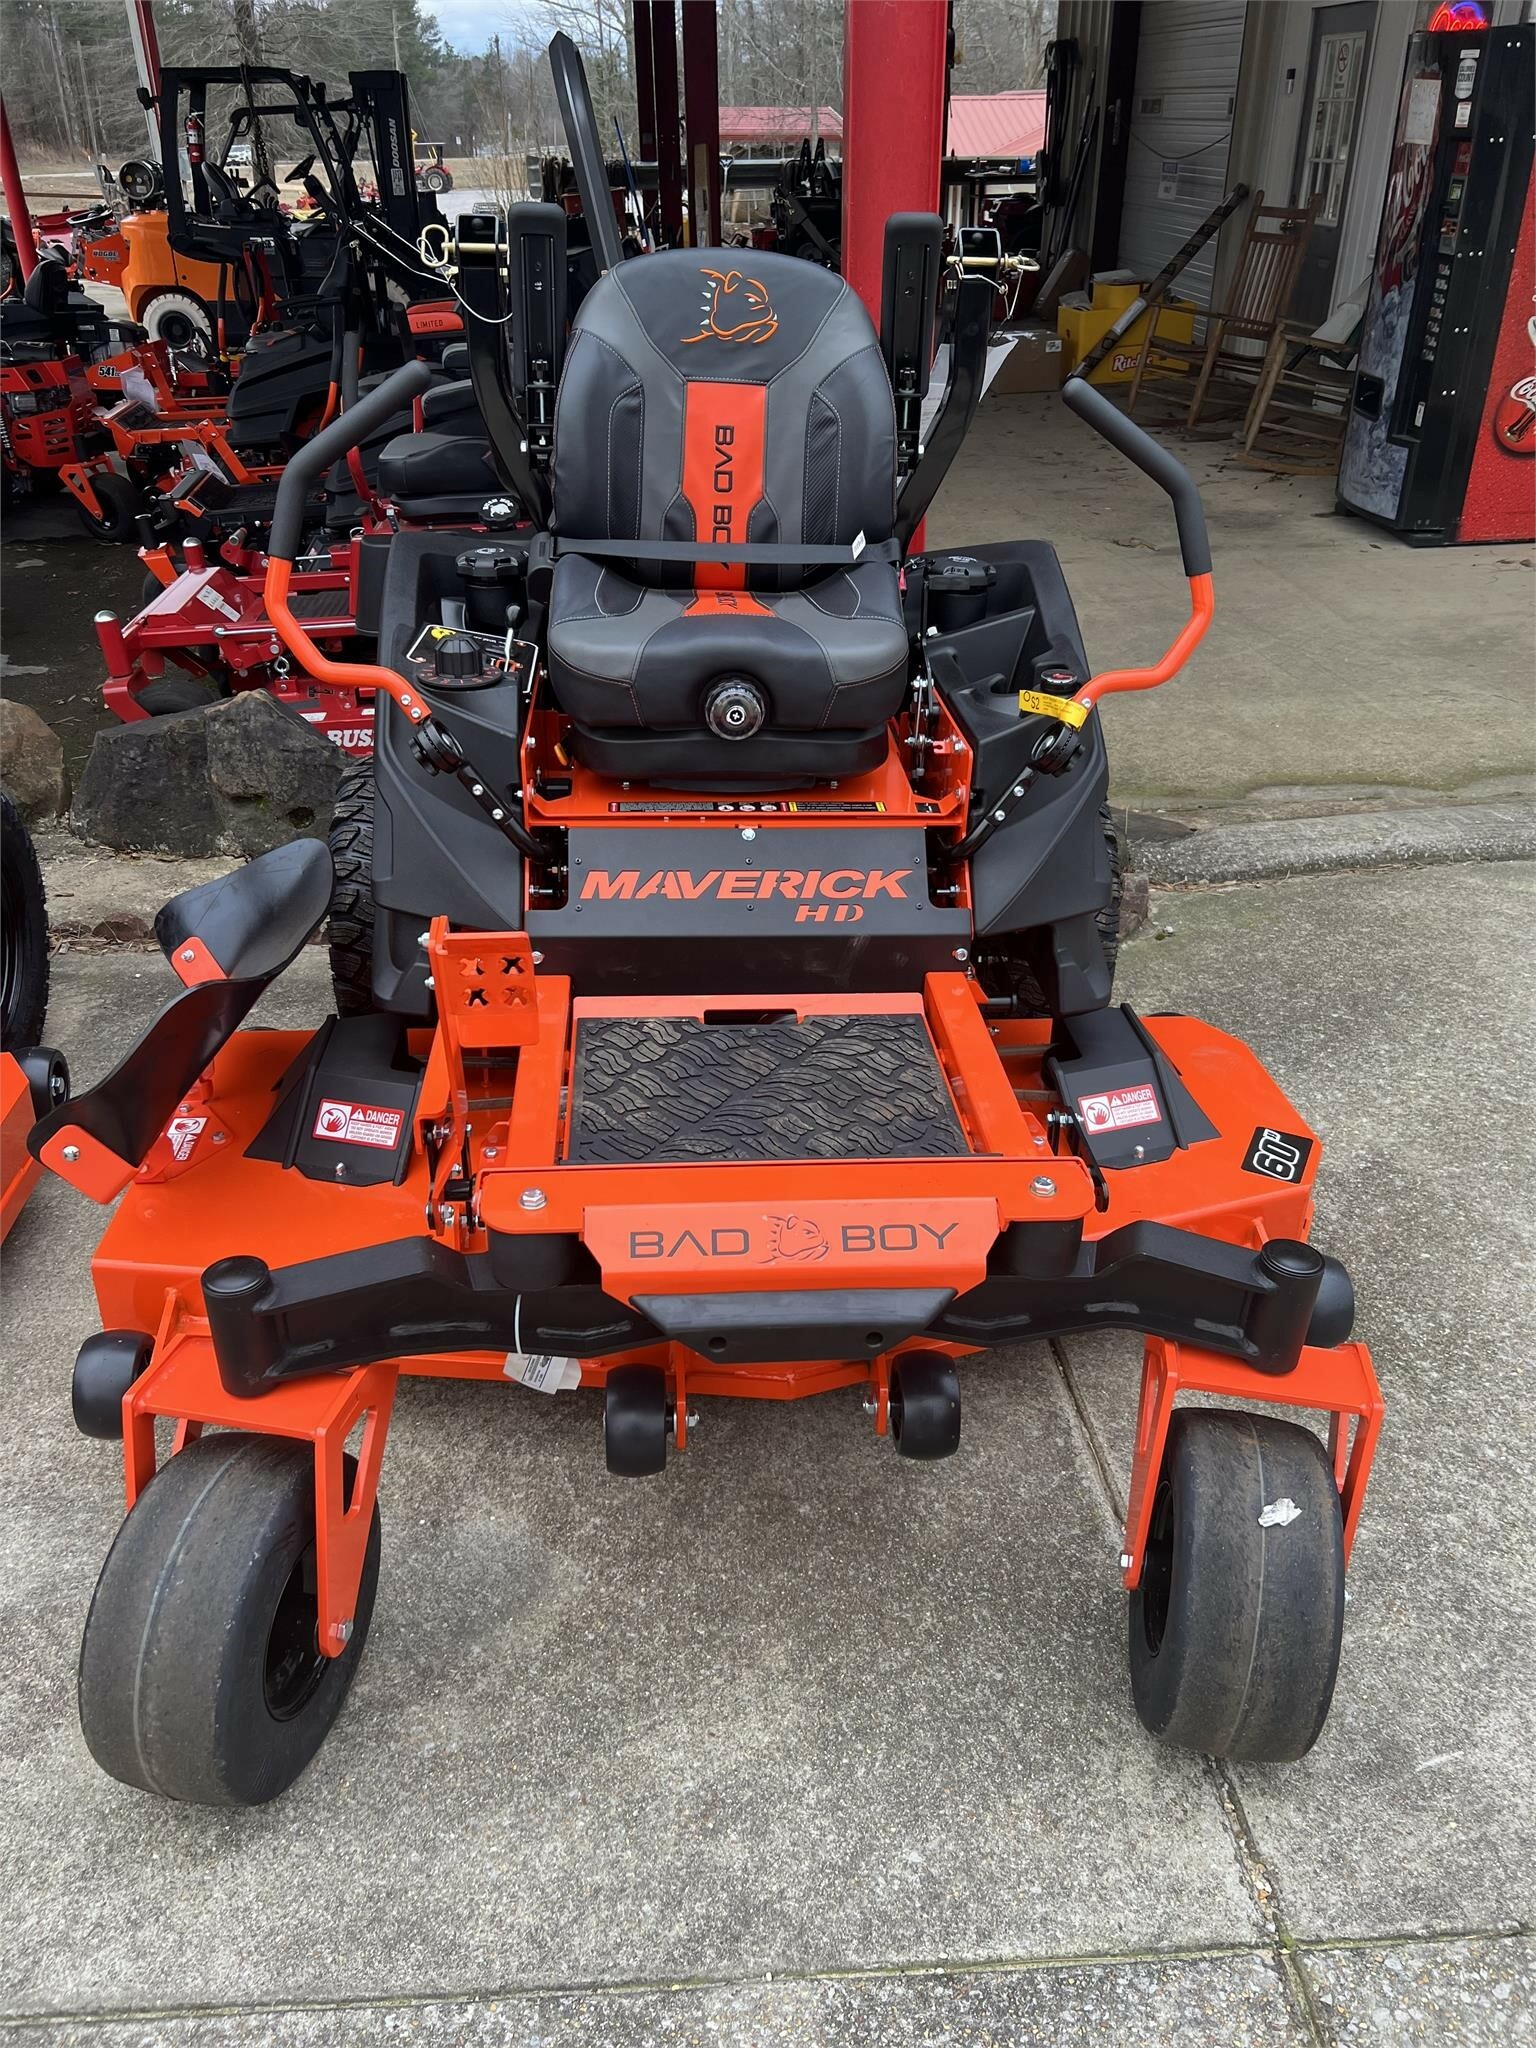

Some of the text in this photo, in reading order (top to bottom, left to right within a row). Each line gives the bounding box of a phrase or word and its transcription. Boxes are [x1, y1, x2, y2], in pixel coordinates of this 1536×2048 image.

[388, 117, 400, 168] DOOSAN
[415, 319, 444, 329] LIMITED
[714, 425, 735, 493] BAD
[712, 505, 732, 570] BO
[327, 728, 375, 748] BUS
[579, 870, 913, 900] MAVERICK
[794, 903, 865, 922] HD
[1121, 1089, 1153, 1104] DANGER
[365, 1110, 400, 1126] DANGER
[629, 1222, 960, 1259] BAD BOY
